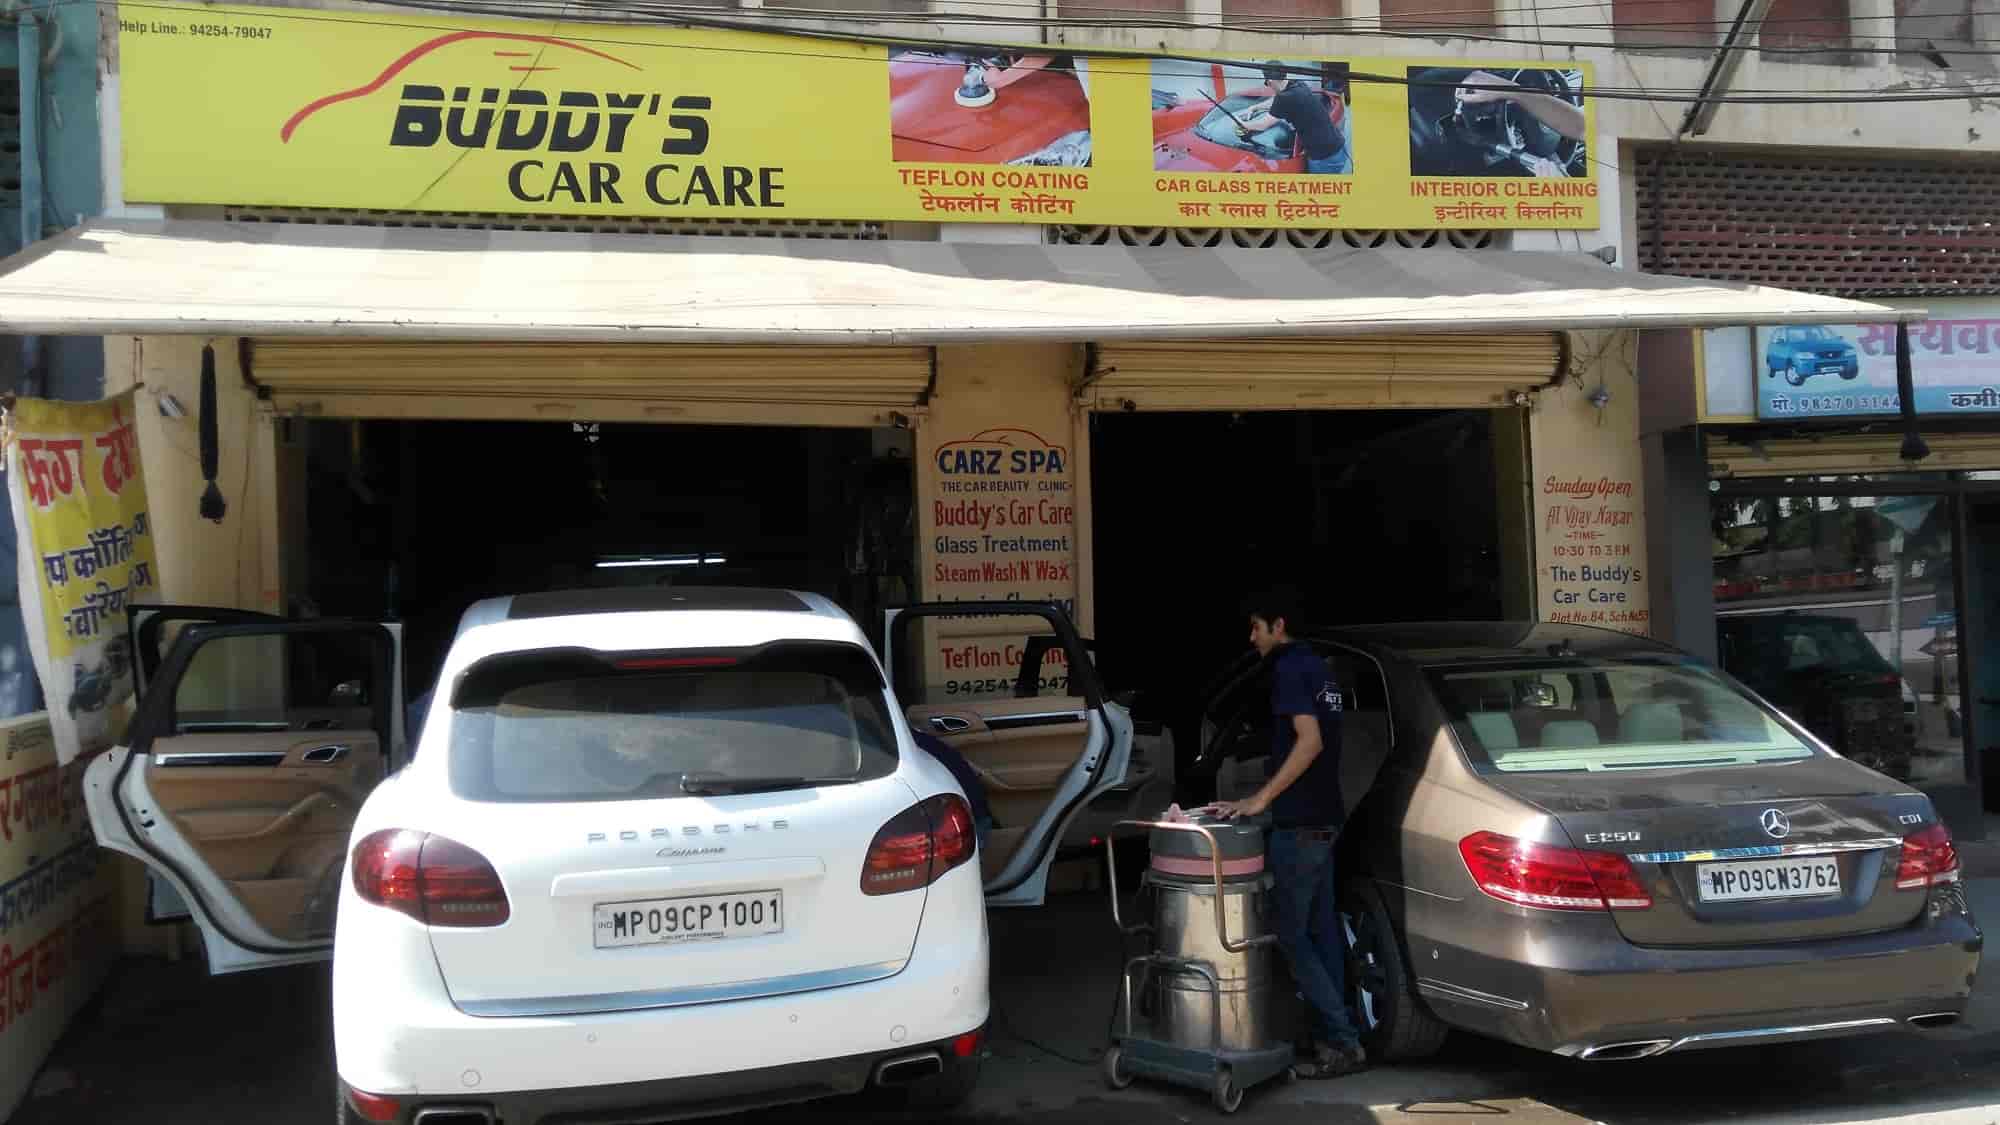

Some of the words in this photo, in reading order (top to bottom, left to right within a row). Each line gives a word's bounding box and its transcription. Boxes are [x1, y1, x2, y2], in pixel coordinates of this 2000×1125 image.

[119, 20, 147, 35] Help
[189, 24, 273, 39] 94254-79047
[390, 84, 712, 155] BUDDY'S
[508, 160, 624, 204] CAR
[644, 164, 785, 208] CARE
[898, 169, 985, 187] TEFLON
[991, 172, 1089, 190] COATING
[1155, 179, 1190, 193] CAR
[1196, 180, 1250, 193] GLASS
[1255, 181, 1353, 194] TREATMENT
[1410, 182, 1499, 197] INTERIOR
[1504, 183, 1598, 197] CLEANING
[1178, 202, 1211, 217] कार
[1218, 202, 1268, 218] ग्लास
[1949, 388, 2000, 408] कमी
[939, 449, 1002, 475] CARZ
[1010, 449, 1063, 474] SPA
[943, 482, 961, 492] THE
[963, 482, 989, 492] CAR
[990, 481, 1029, 492] BEAUTY
[1543, 475, 1596, 499] Sunday
[1597, 477, 1632, 500] Open
[934, 499, 1006, 530] Buddy's
[1009, 500, 1034, 525] Car
[1038, 499, 1073, 525] Care
[935, 536, 978, 554] Glass
[981, 535, 1069, 553] Treatment
[935, 563, 980, 582] Steam
[981, 561, 1017, 582] Wash
[1035, 559, 1070, 581] Wax
[1550, 565, 1577, 581] The
[1581, 564, 1642, 584] Buddy's
[1553, 589, 1580, 603] Car
[1588, 587, 1626, 602] Care
[942, 646, 1000, 669] Teflon
[587, 819, 789, 842] PORSCHE
[1711, 864, 1838, 894] MP09CN3762
[613, 899, 778, 939] MP09CP1001
